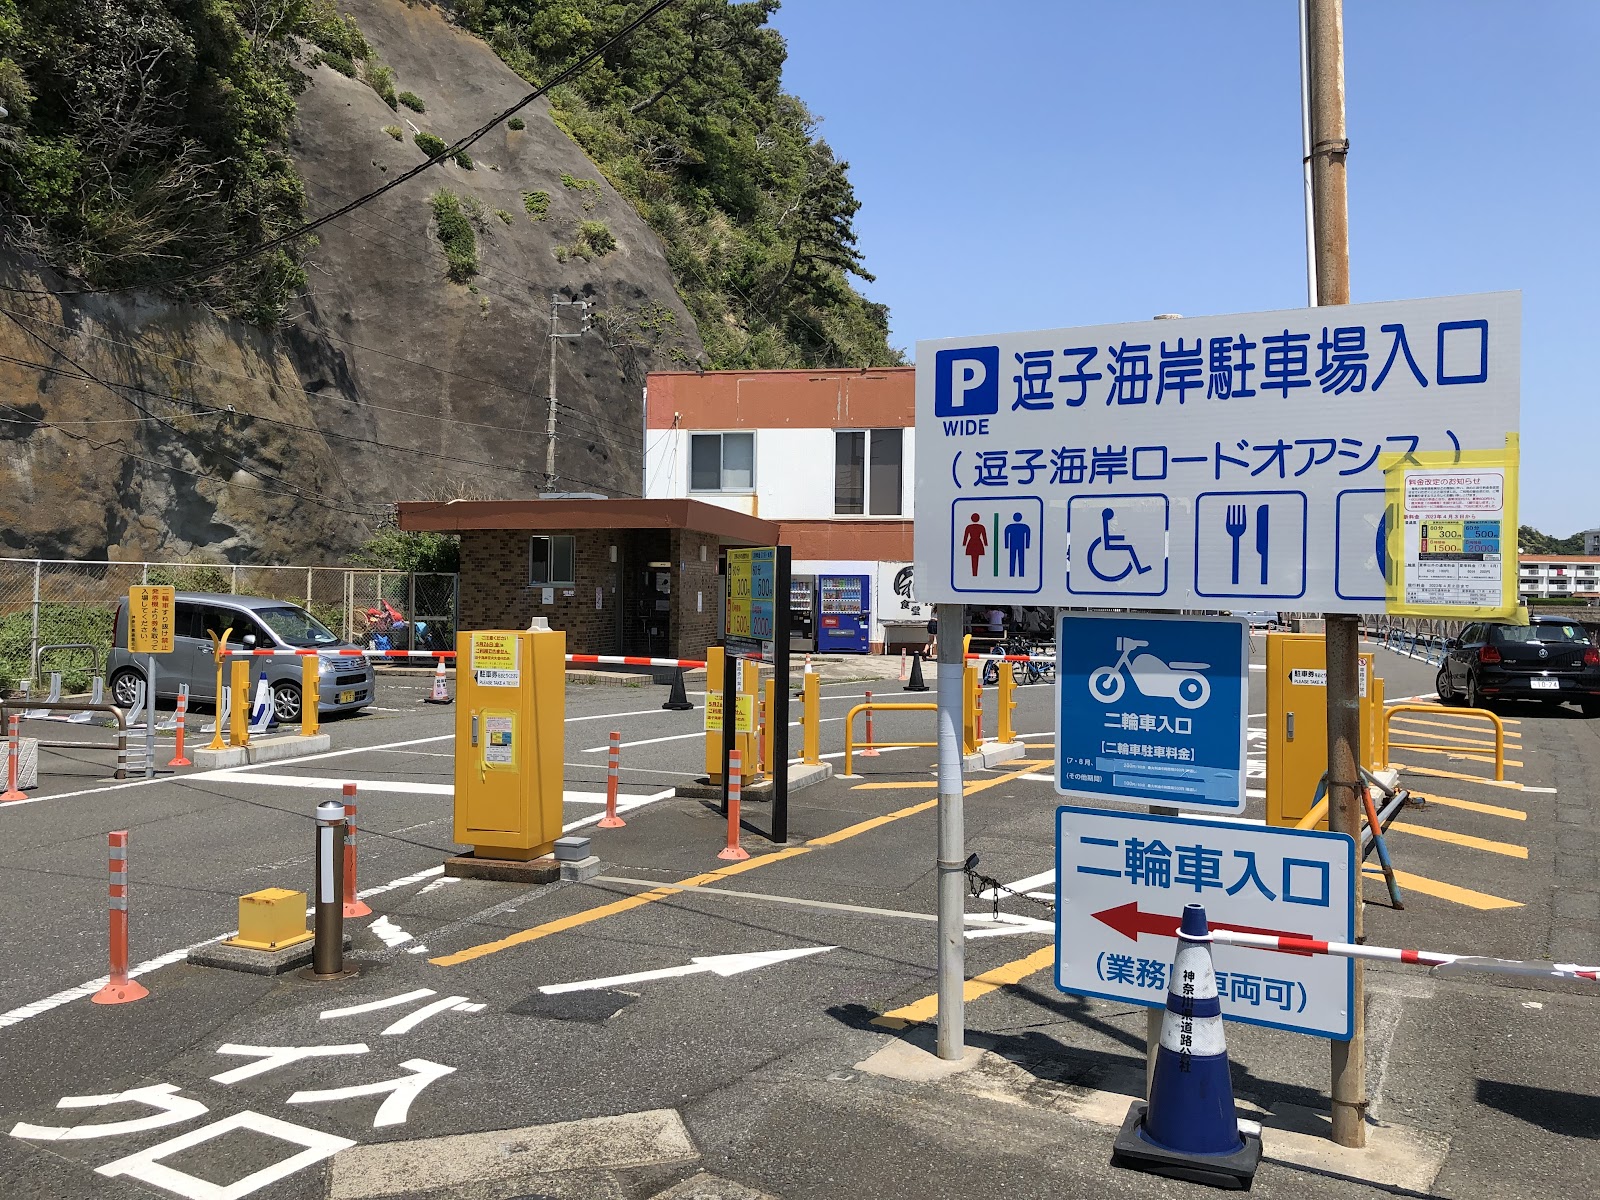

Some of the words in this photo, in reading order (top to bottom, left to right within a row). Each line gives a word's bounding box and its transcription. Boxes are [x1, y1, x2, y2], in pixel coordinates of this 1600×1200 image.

[1010, 318, 1489, 412] 逗子海岸駐車場入口
[942, 418, 990, 437] WIDE
[1408, 478, 1481, 486] 料金改定のお知らせ
[1104, 711, 1192, 736] 二輪車入口
[1077, 835, 1330, 908] 二輪車入口
[1096, 951, 1308, 1014] (業務両可)
[1178, 969, 1196, 1074] 神奈川県道路公社
